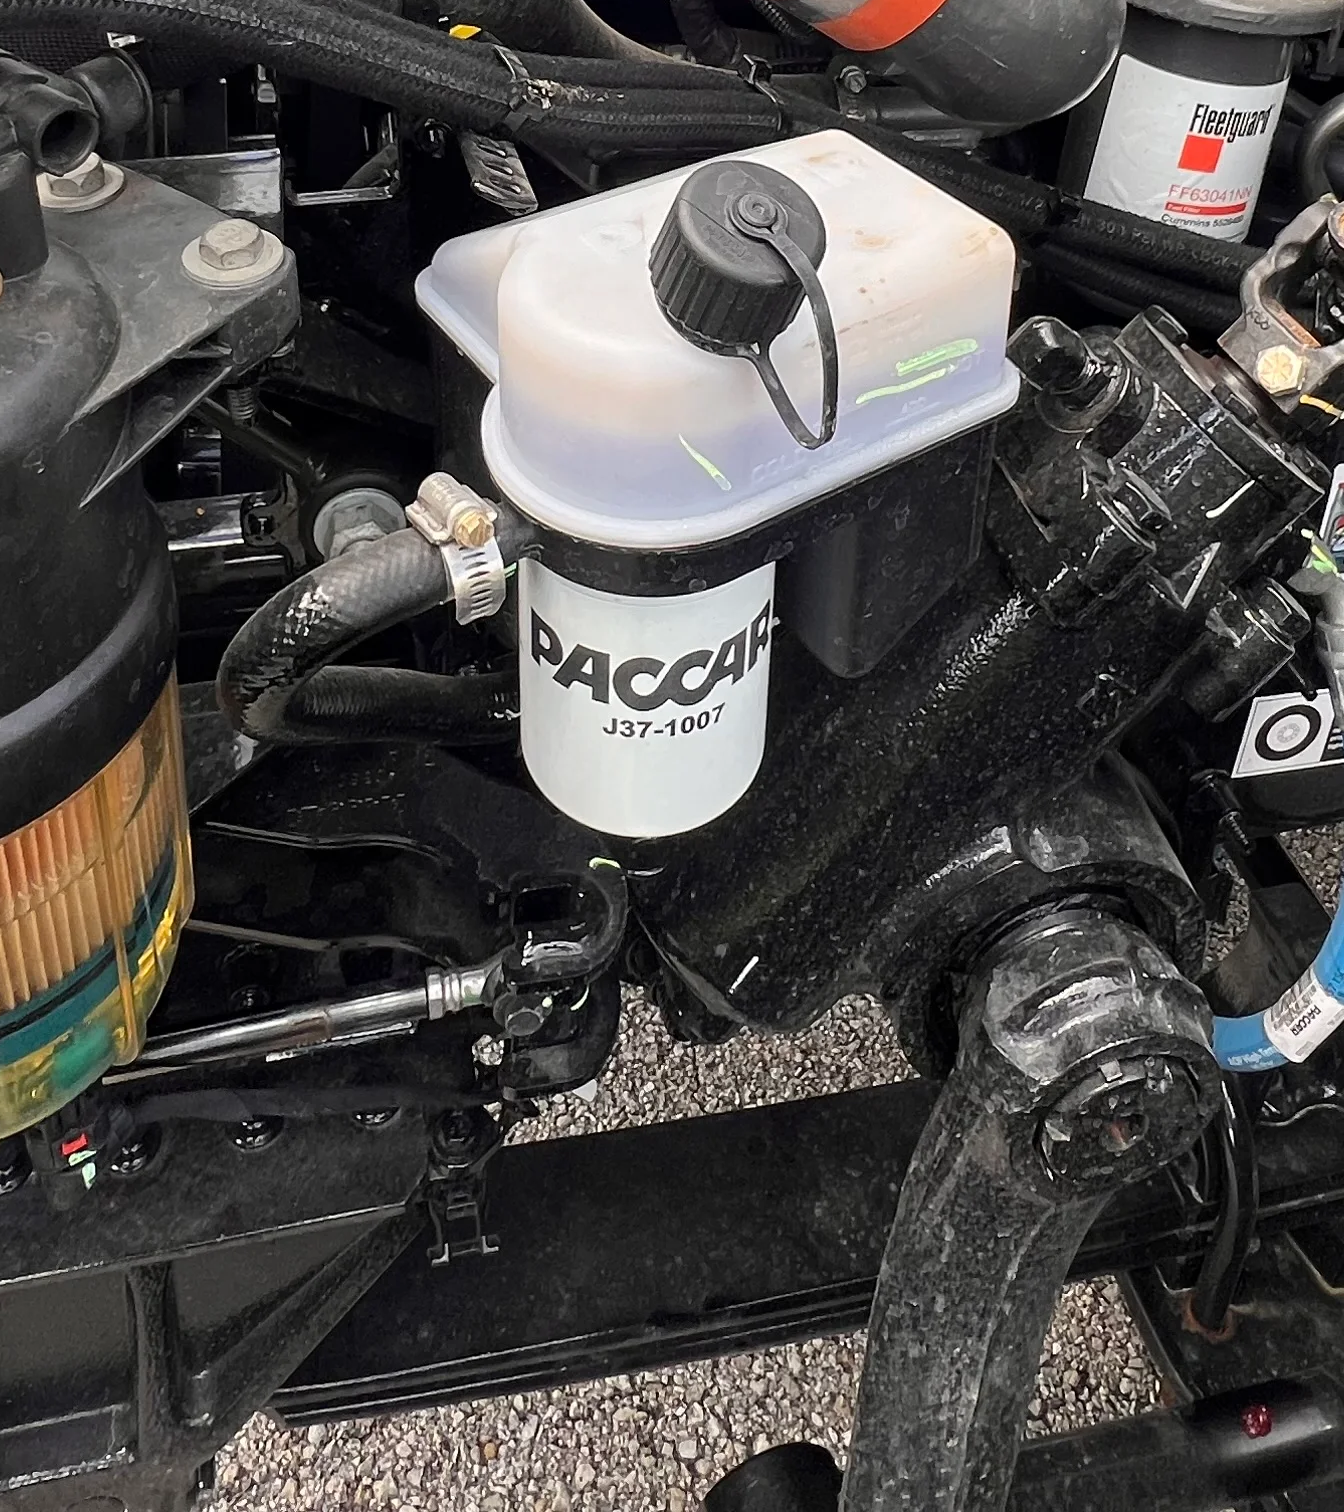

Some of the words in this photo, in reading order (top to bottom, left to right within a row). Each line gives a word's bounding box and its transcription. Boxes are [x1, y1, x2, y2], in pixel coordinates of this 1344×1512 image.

[1188, 103, 1274, 143] Fleetguard
[1167, 184, 1254, 203] FF63041NN
[1160, 213, 1211, 228] Cummins
[530, 598, 771, 711] PACCAR
[602, 702, 726, 739] J37-1007
